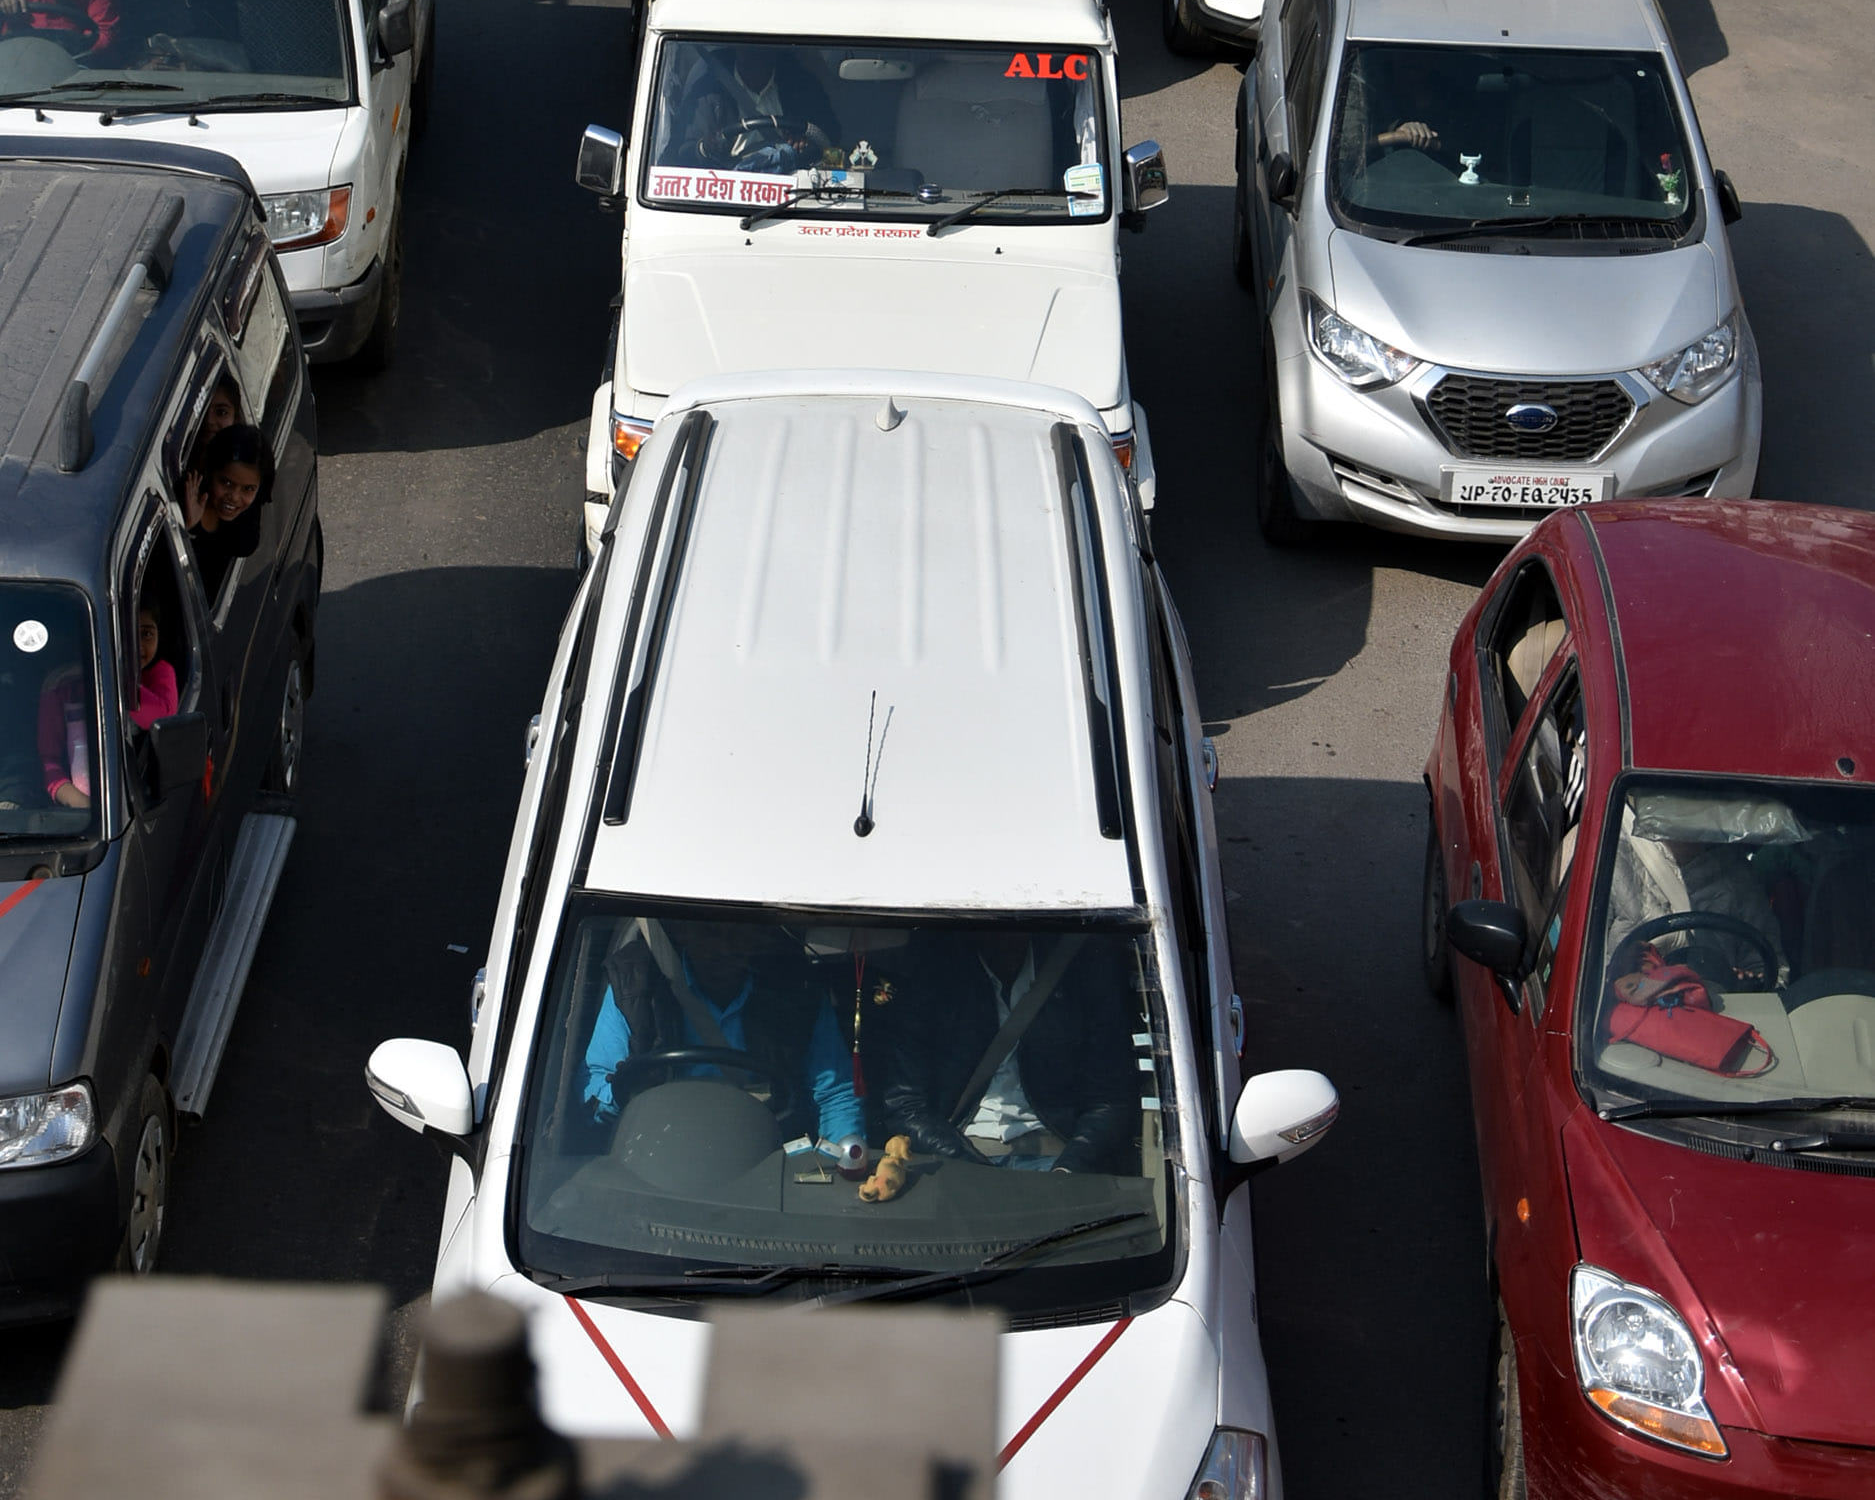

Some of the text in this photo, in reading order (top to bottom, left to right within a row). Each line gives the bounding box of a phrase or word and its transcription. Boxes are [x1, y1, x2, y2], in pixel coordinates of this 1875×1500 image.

[1004, 52, 1088, 80] ALC
[653, 171, 793, 205] उत्तर प्रदेश सरकार
[797, 224, 921, 239] उत्तर प्रदेश सरकार
[1492, 475, 1571, 487] ADVOCATE HIGH COURT
